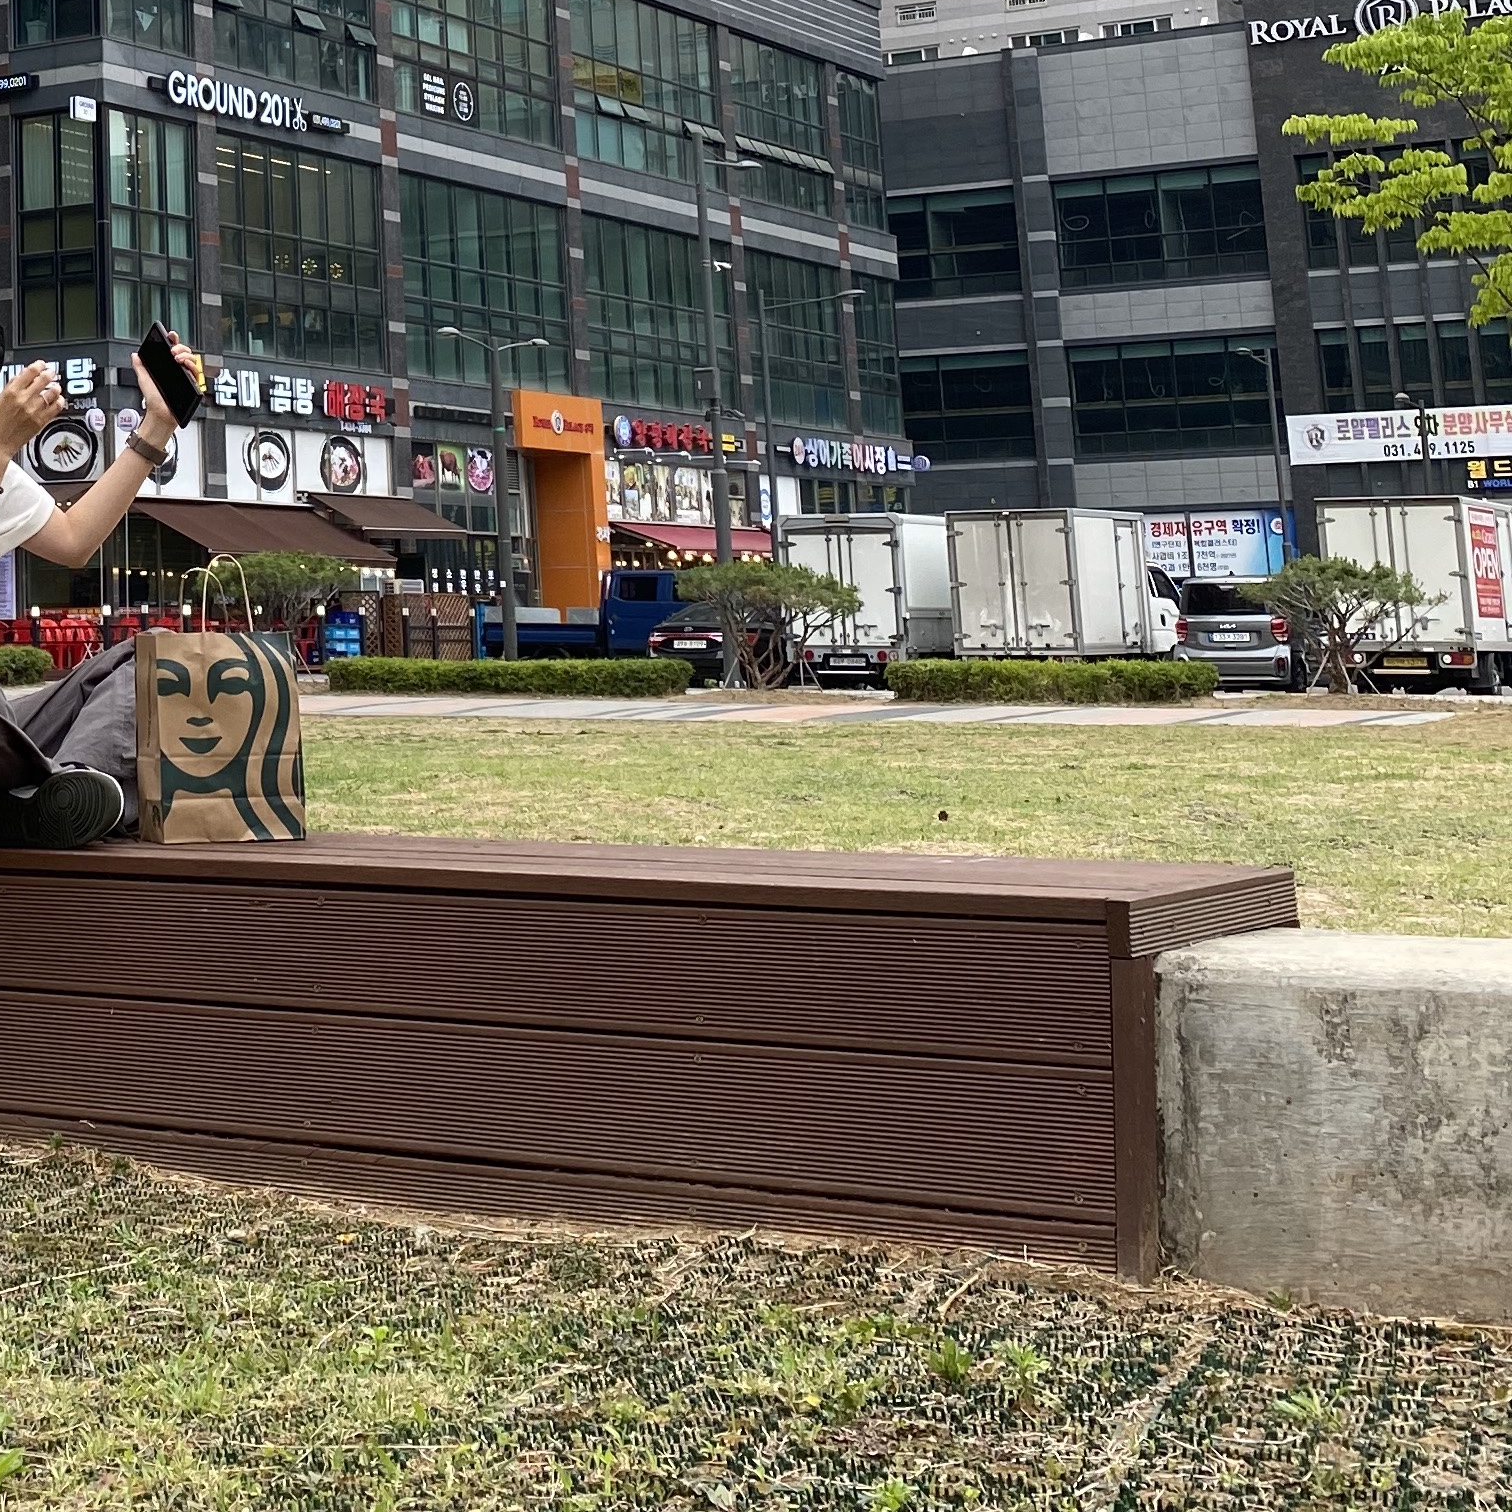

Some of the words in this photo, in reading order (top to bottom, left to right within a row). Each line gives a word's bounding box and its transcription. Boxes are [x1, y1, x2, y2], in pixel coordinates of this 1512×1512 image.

[1248, 14, 1346, 46] ROYAL
[167, 70, 257, 120] GROUND
[260, 92, 292, 128] 201
[214, 368, 261, 408] 순대
[269, 374, 315, 415] 곰탕
[323, 379, 386, 423] 해장국
[1336, 415, 1411, 442] 로얄팰리스
[1383, 440, 1475, 457] 031.49.1125
[1232, 518, 1261, 535] 확정!
[1473, 546, 1502, 580] OPEN
